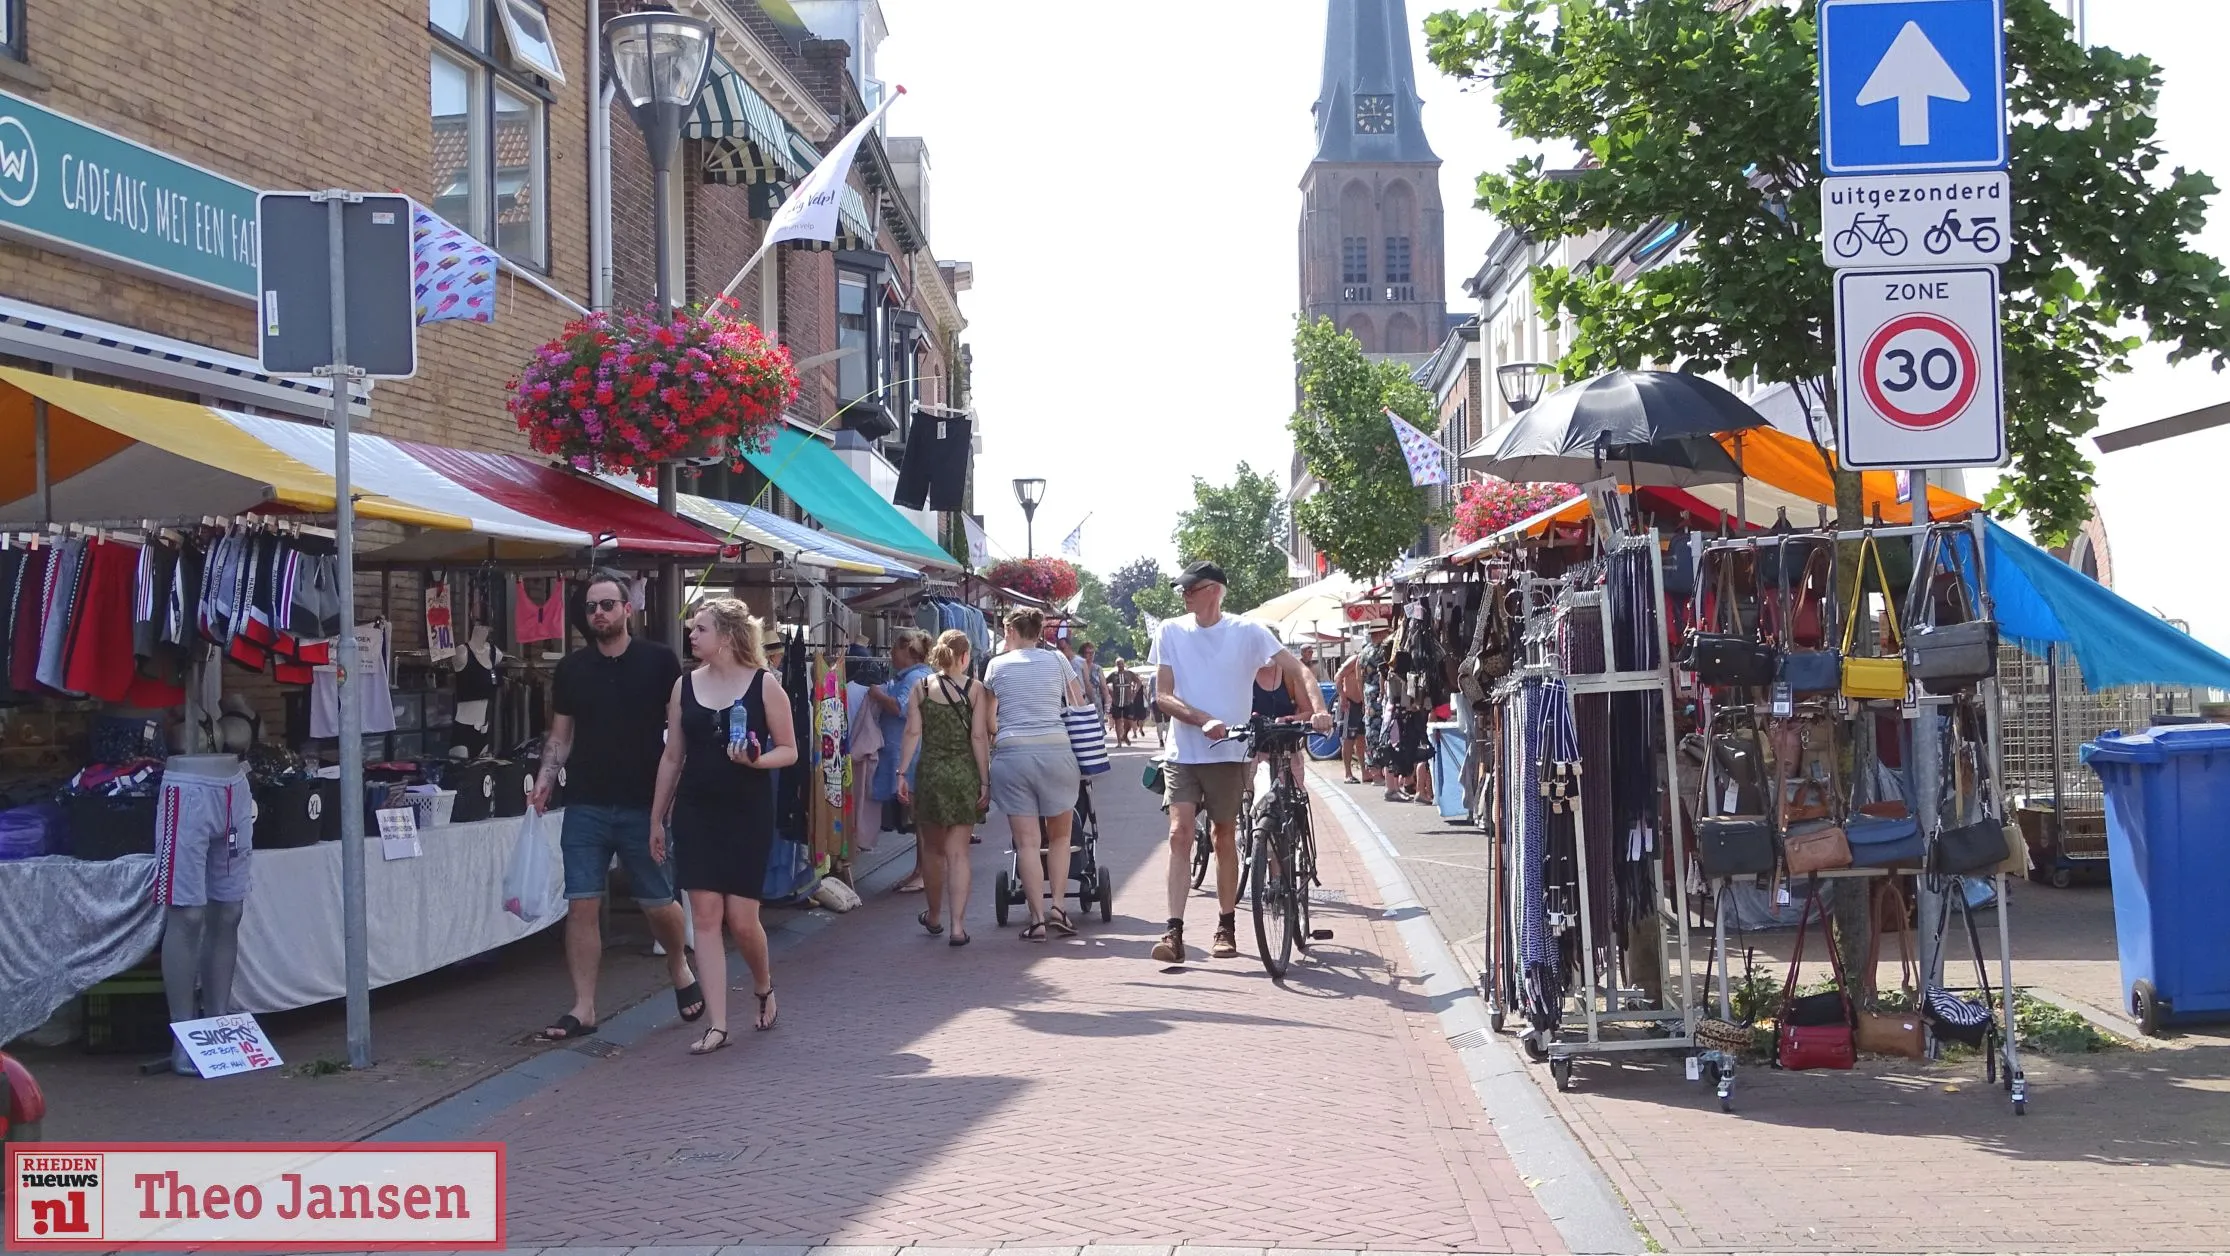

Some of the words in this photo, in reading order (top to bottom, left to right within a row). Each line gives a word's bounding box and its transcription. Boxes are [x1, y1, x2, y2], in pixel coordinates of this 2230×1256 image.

[1831, 183, 2000, 208] uitgezonderd
[62, 153, 148, 234] CADEAUS
[156, 187, 188, 246] MET
[195, 201, 225, 258] EEN
[231, 214, 257, 268] FAI
[1885, 283, 1949, 301] ZONE
[1882, 347, 1957, 392] 30
[244, 577, 255, 612] HANDSOME
[310, 800, 321, 818] XL
[188, 1026, 259, 1046] SHORTS
